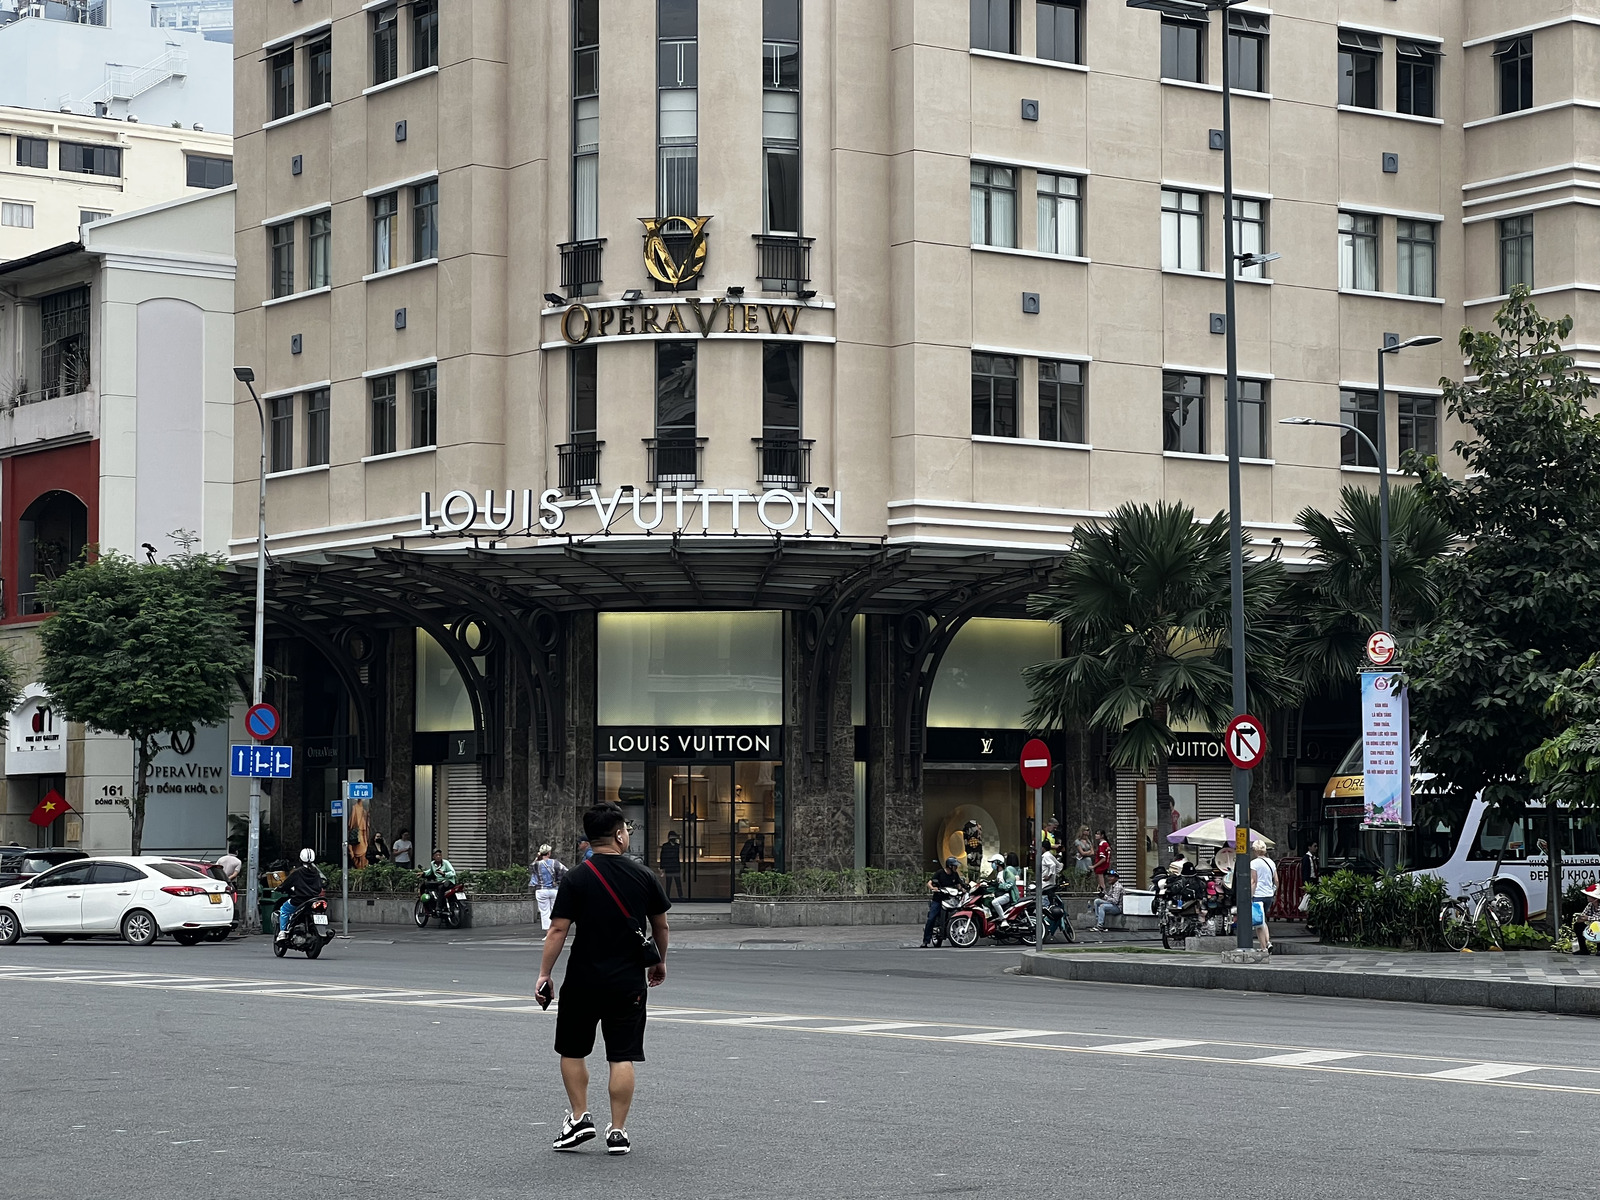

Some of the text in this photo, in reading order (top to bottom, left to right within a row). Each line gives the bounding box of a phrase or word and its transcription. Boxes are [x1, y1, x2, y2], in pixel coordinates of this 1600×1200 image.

[420, 487, 842, 533] LOUIS VUITTON
[609, 735, 771, 752] LOUIS VUITTON
[1336, 778, 1364, 789] L'ORE
[102, 785, 123, 796] 161
[1567, 870, 1596, 881] KHOA
